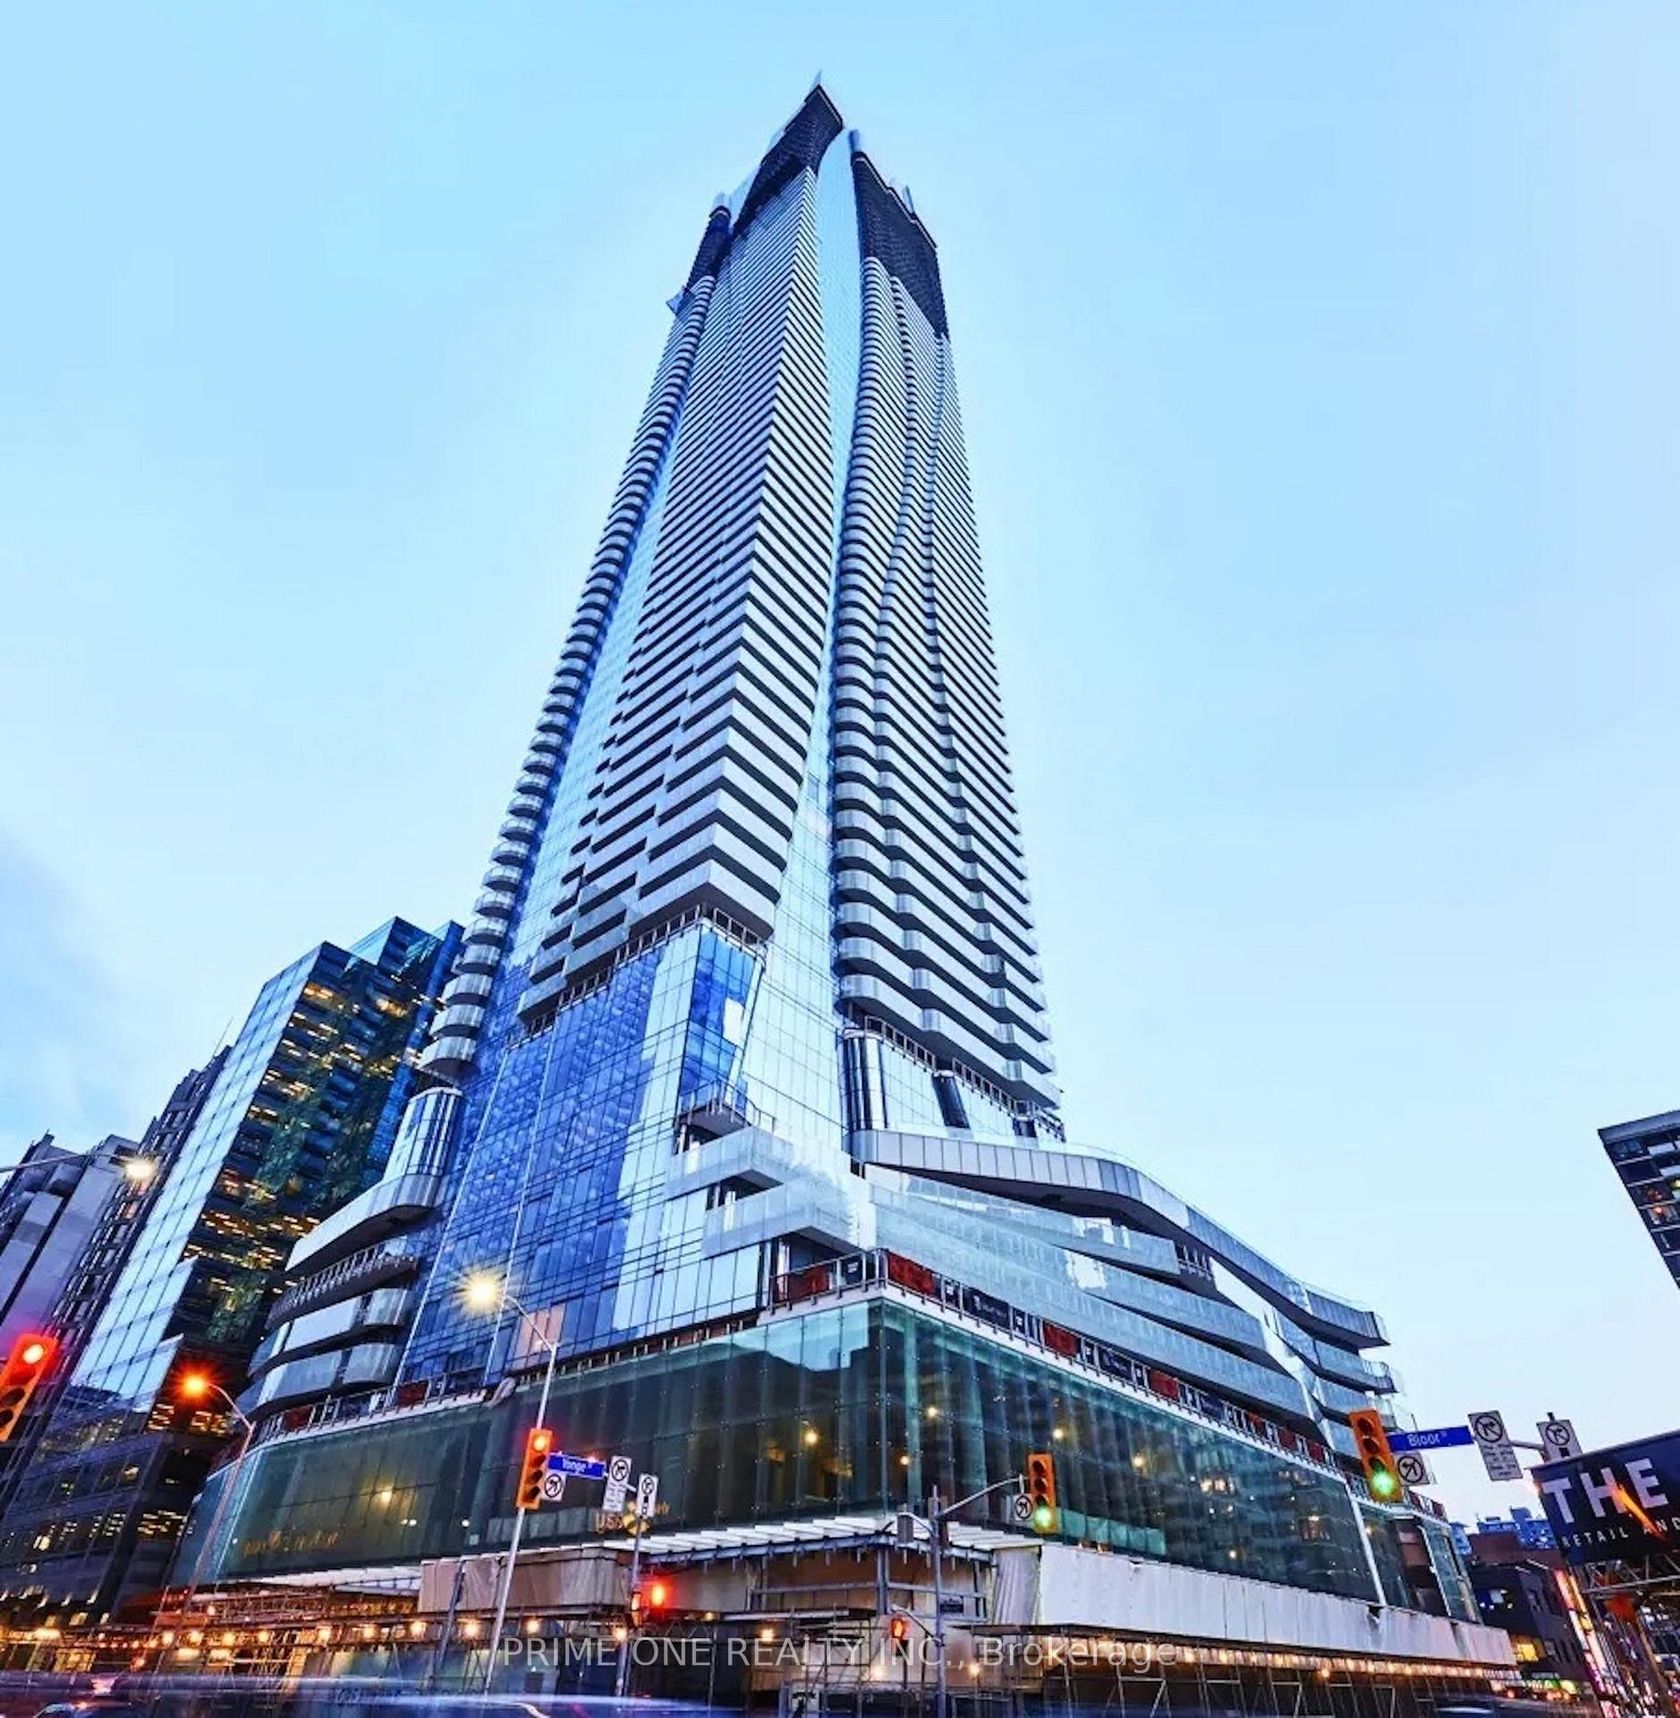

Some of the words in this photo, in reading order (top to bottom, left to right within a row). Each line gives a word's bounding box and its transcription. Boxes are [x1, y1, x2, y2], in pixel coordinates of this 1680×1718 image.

[1407, 1433, 1440, 1447] Bloor
[562, 1458, 587, 1475] Yonge
[1541, 1458, 1669, 1524] THE
[1561, 1527, 1629, 1548] RETAIL
